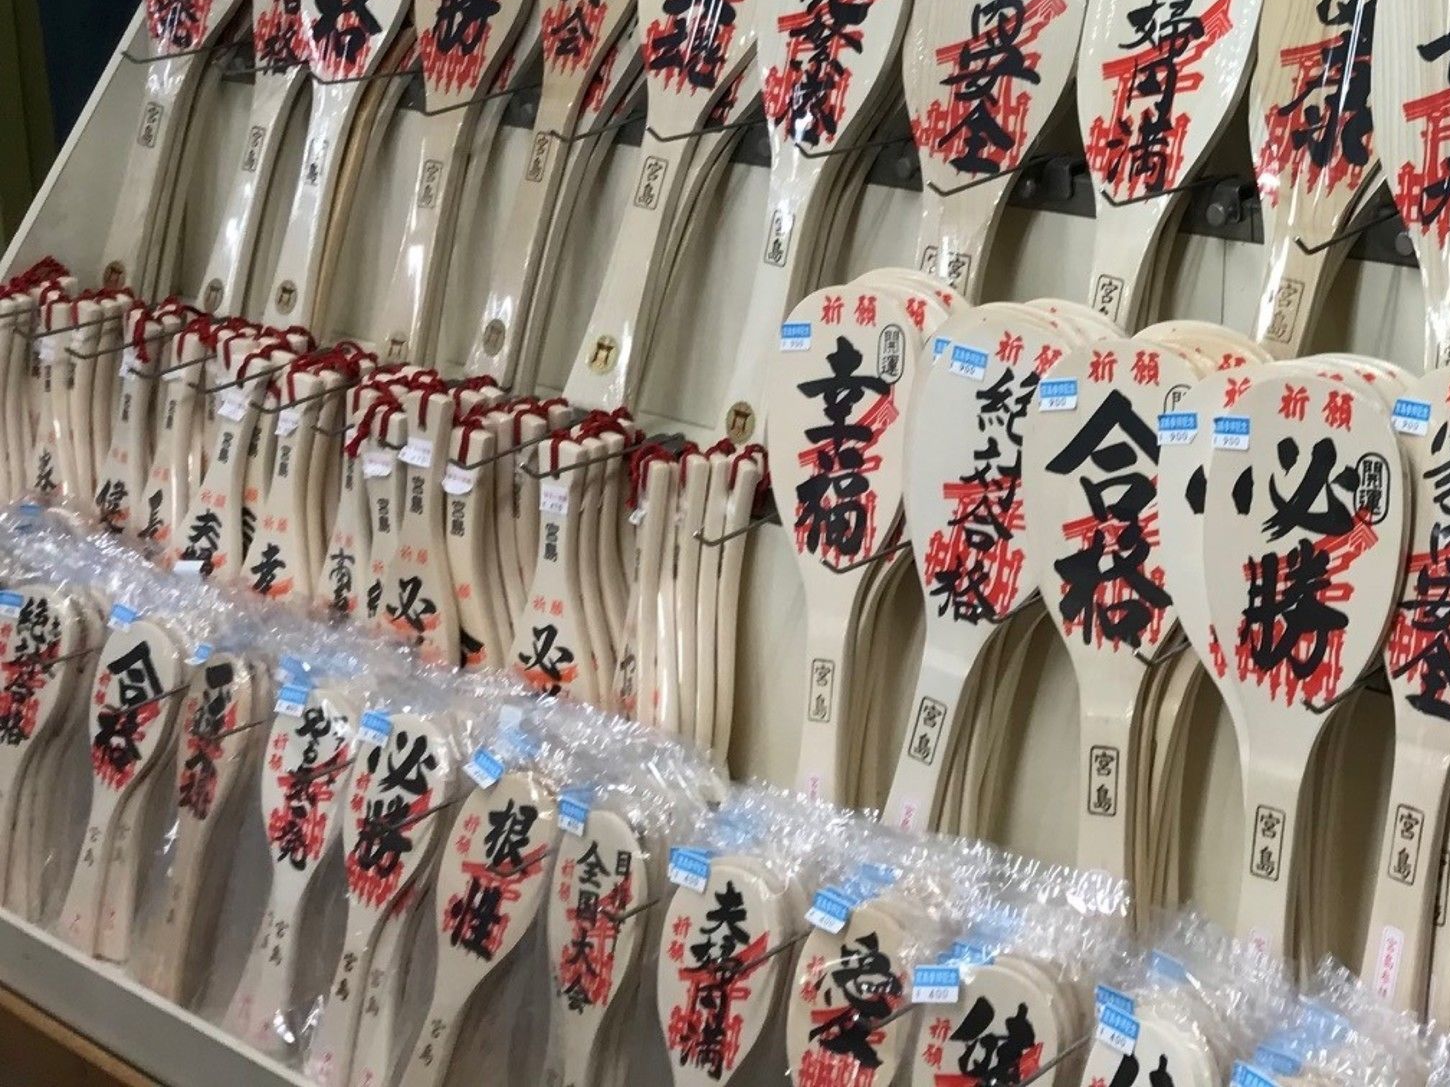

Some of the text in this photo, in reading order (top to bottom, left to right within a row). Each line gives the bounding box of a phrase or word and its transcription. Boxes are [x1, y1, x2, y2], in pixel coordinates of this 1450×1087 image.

[638, 161, 662, 206] 宮島
[820, 294, 877, 327] 祈願
[1088, 349, 1161, 387] 祈願
[1278, 383, 1354, 431] 祈願
[796, 336, 891, 556] 幸福
[1045, 389, 1173, 648] 合格
[1232, 437, 1360, 681] 必勝
[94, 641, 165, 772] 合格
[811, 665, 832, 720] 宮島
[914, 703, 942, 761] 宮島
[356, 730, 439, 879] 必勝
[1092, 751, 1115, 813] 宮島
[1256, 813, 1280, 875] 宮島
[1394, 812, 1419, 879] 宮島
[450, 798, 539, 963] 根性
[809, 932, 903, 1068] 愛
